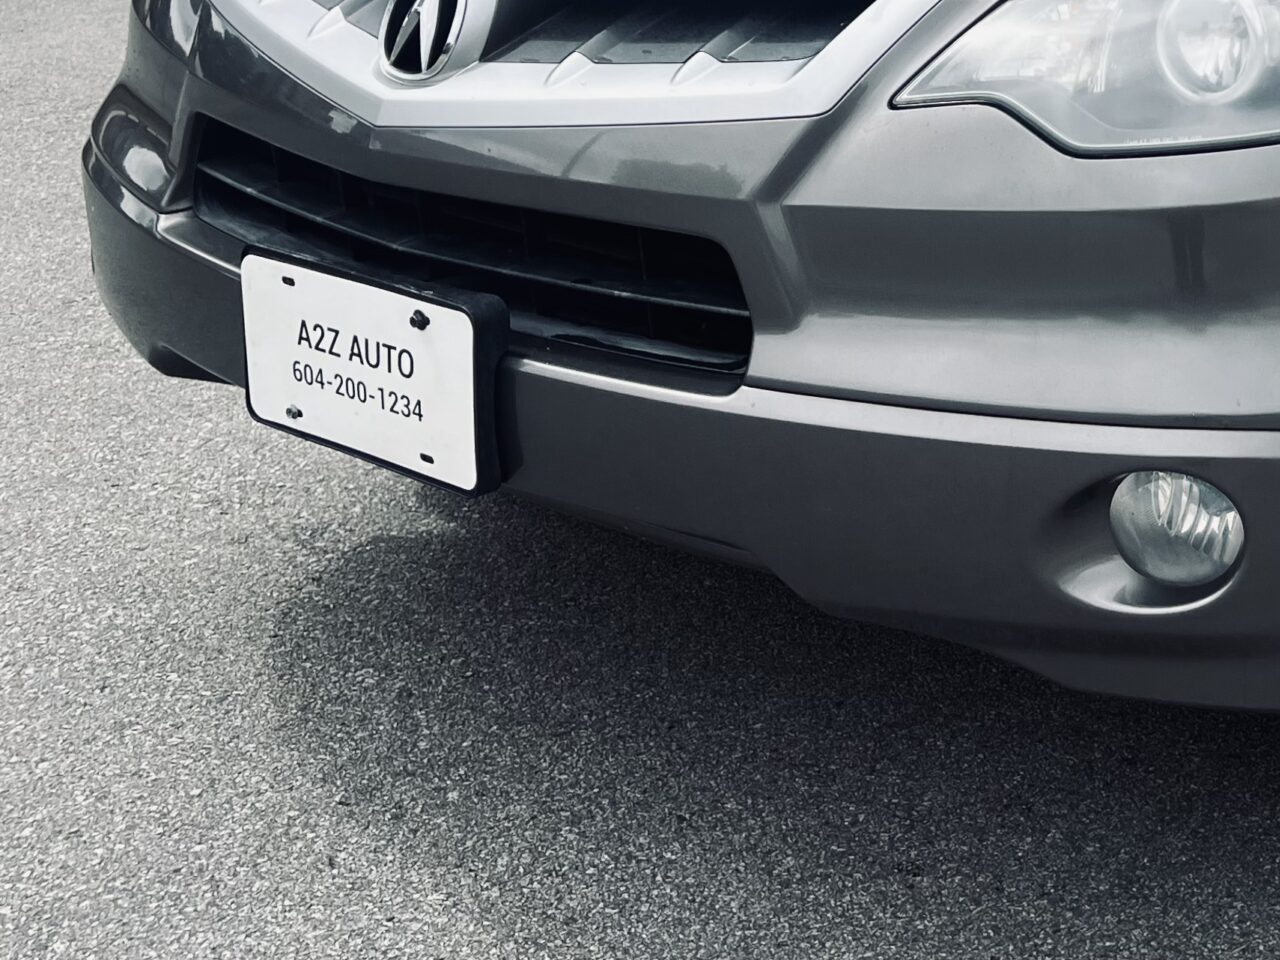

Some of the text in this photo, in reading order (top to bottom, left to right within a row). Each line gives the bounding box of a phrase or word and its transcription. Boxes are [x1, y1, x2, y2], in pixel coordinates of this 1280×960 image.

[297, 319, 415, 379] A2Z AUTO
[292, 360, 424, 422] 604-200-1234
